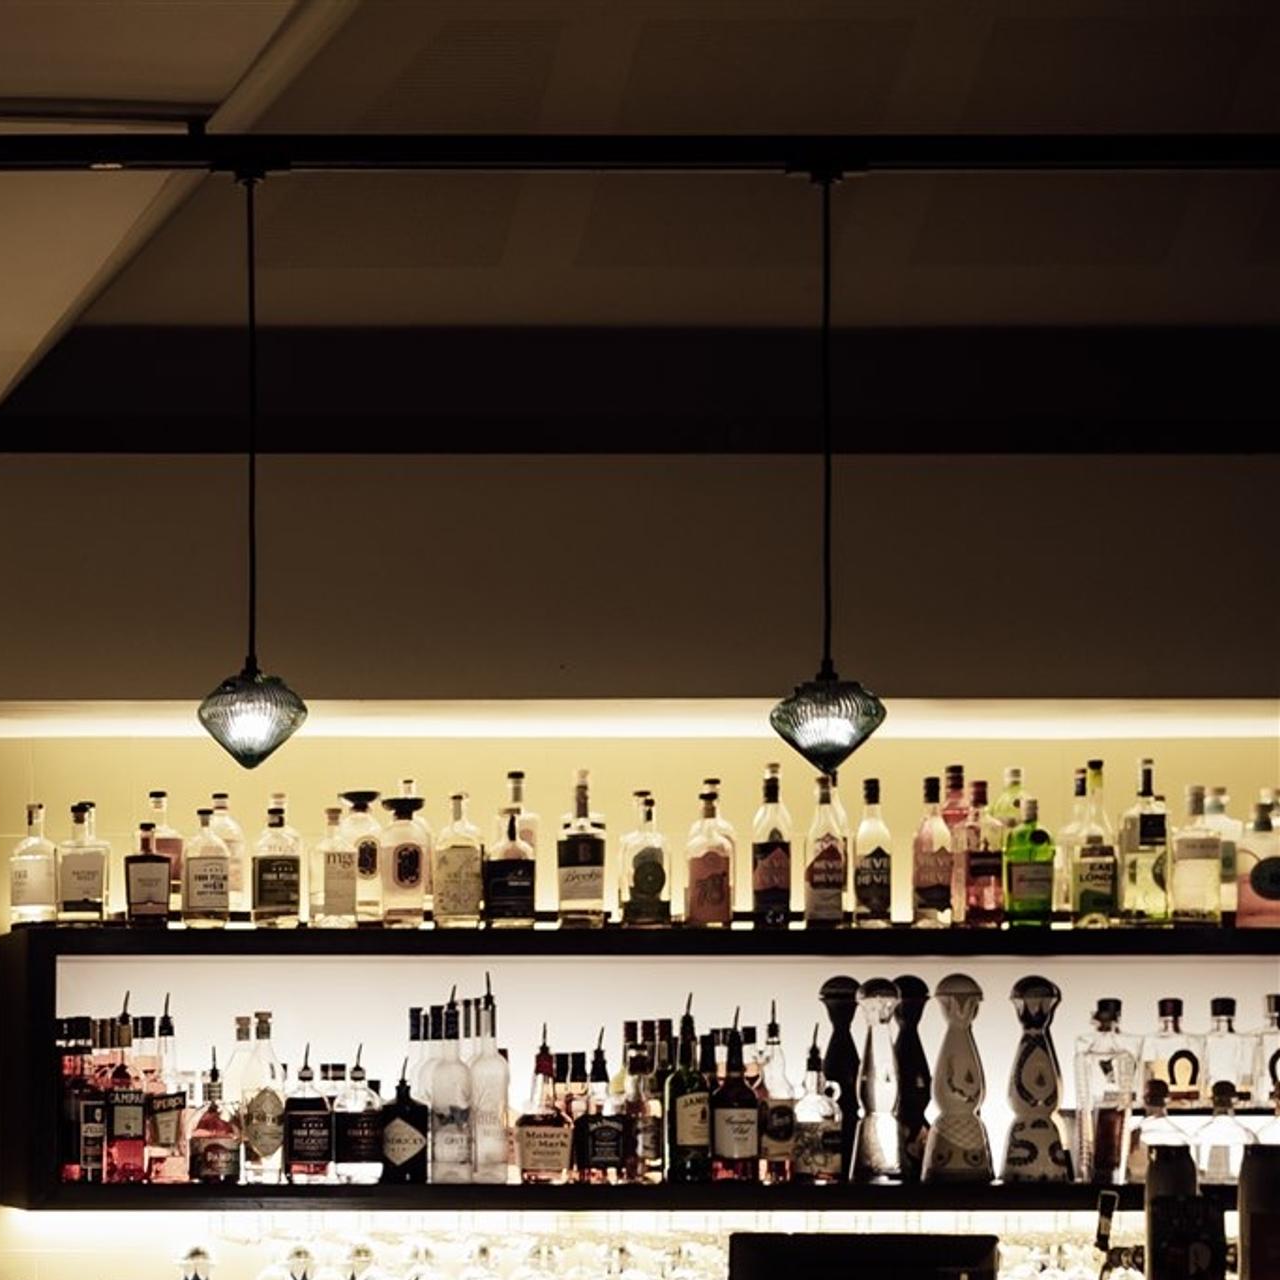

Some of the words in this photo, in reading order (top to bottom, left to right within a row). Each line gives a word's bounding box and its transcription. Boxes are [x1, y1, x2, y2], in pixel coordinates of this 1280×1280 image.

[109, 1092, 146, 1104] CAMPA
[683, 1096, 709, 1107] JAME
[539, 1139, 568, 1148] Mark
